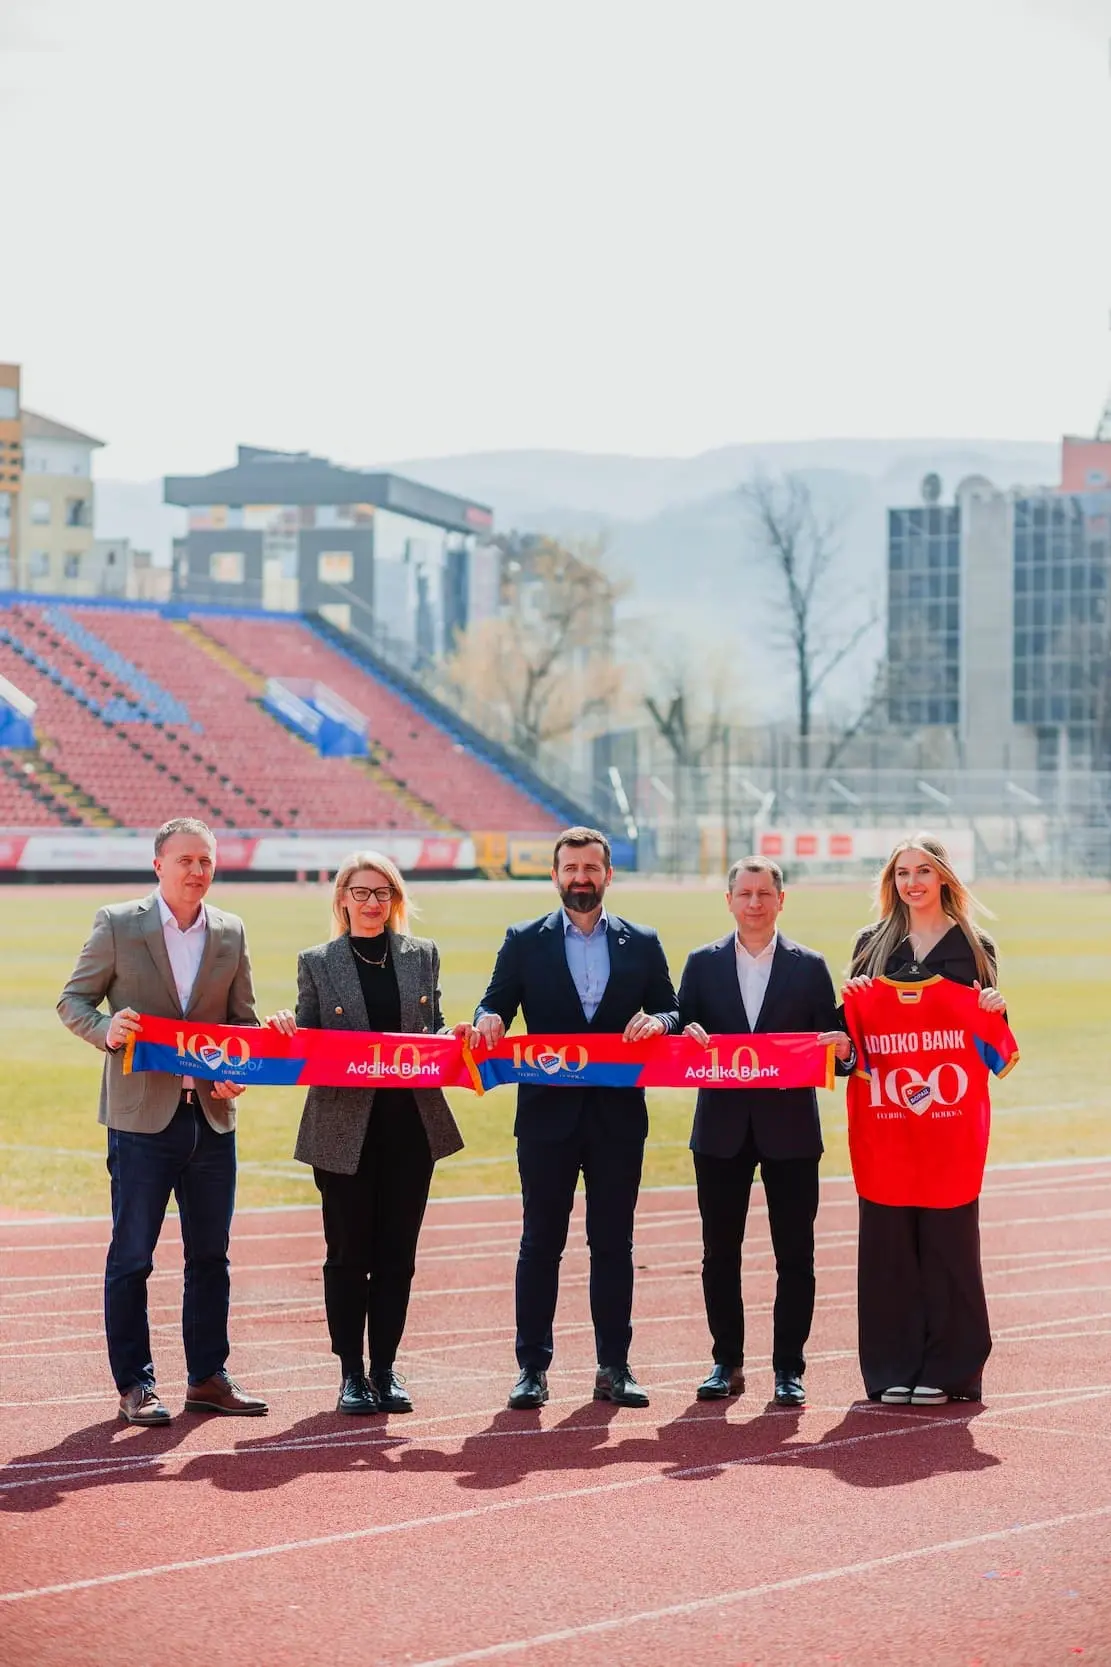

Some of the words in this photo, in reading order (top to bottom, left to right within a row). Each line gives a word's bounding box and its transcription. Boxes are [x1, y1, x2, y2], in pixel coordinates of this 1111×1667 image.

[175, 1031, 251, 1067] 100
[922, 1030, 965, 1050] BANK
[346, 1061, 400, 1075] Addiko
[401, 1062, 440, 1075] Bank
[366, 1043, 420, 1079] 10
[512, 1043, 588, 1072] 100
[705, 1046, 759, 1082] 10
[740, 1065, 779, 1078] Bank
[868, 1063, 968, 1108] 100
